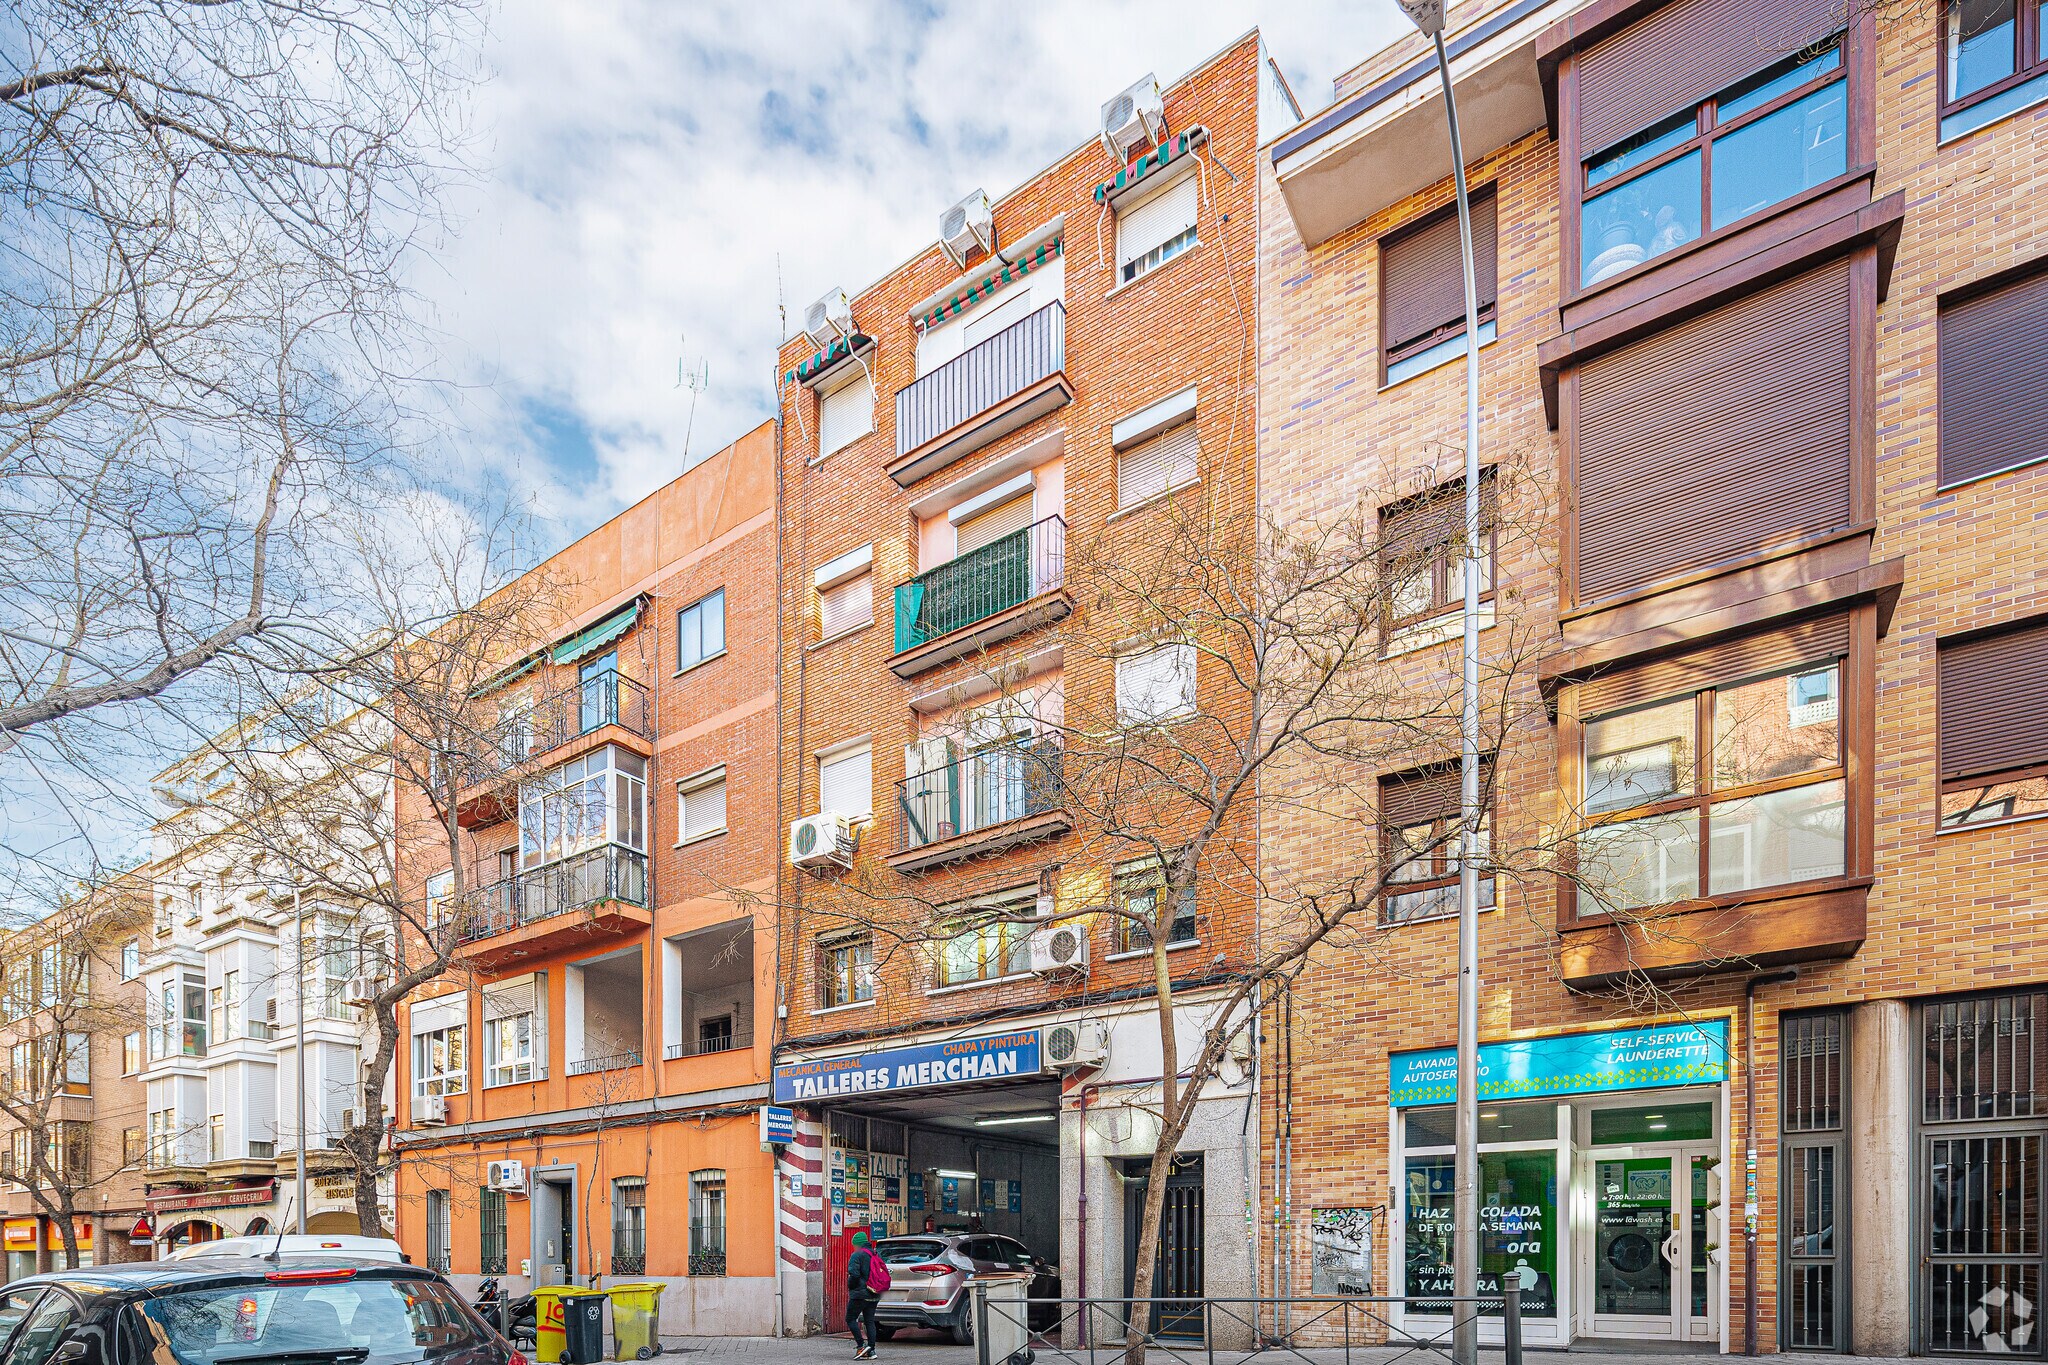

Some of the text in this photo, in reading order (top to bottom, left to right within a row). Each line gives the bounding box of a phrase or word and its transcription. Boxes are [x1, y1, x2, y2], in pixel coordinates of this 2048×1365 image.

[943, 1034, 1036, 1056] CHAPA Y PINTURA
[1610, 1029, 1707, 1049] SELF-SERVICE
[1408, 1054, 1482, 1070] LAVANDA
[1607, 1044, 1711, 1065] LAUNDERETTE
[778, 1058, 862, 1078] MECANICA GENERAL
[793, 1050, 1017, 1099] TALLERES MERCHAN
[1402, 1066, 1490, 1083] AUTOSERIO
[768, 1113, 792, 1122] TALLERES
[767, 1122, 793, 1130] MERCHAN
[870, 1155, 909, 1178] TALLER
[153, 1200, 188, 1209] RESTAURANTE
[1419, 1205, 1542, 1219] HAZ COLADA
[1419, 1224, 1434, 1232] DE
[1437, 1223, 1455, 1232] TO
[1490, 1221, 1542, 1231] SEMANA
[1506, 1241, 1542, 1254] ora
[1419, 1264, 1482, 1277] sin plaa
[1419, 1279, 1499, 1291] Y AHRA
